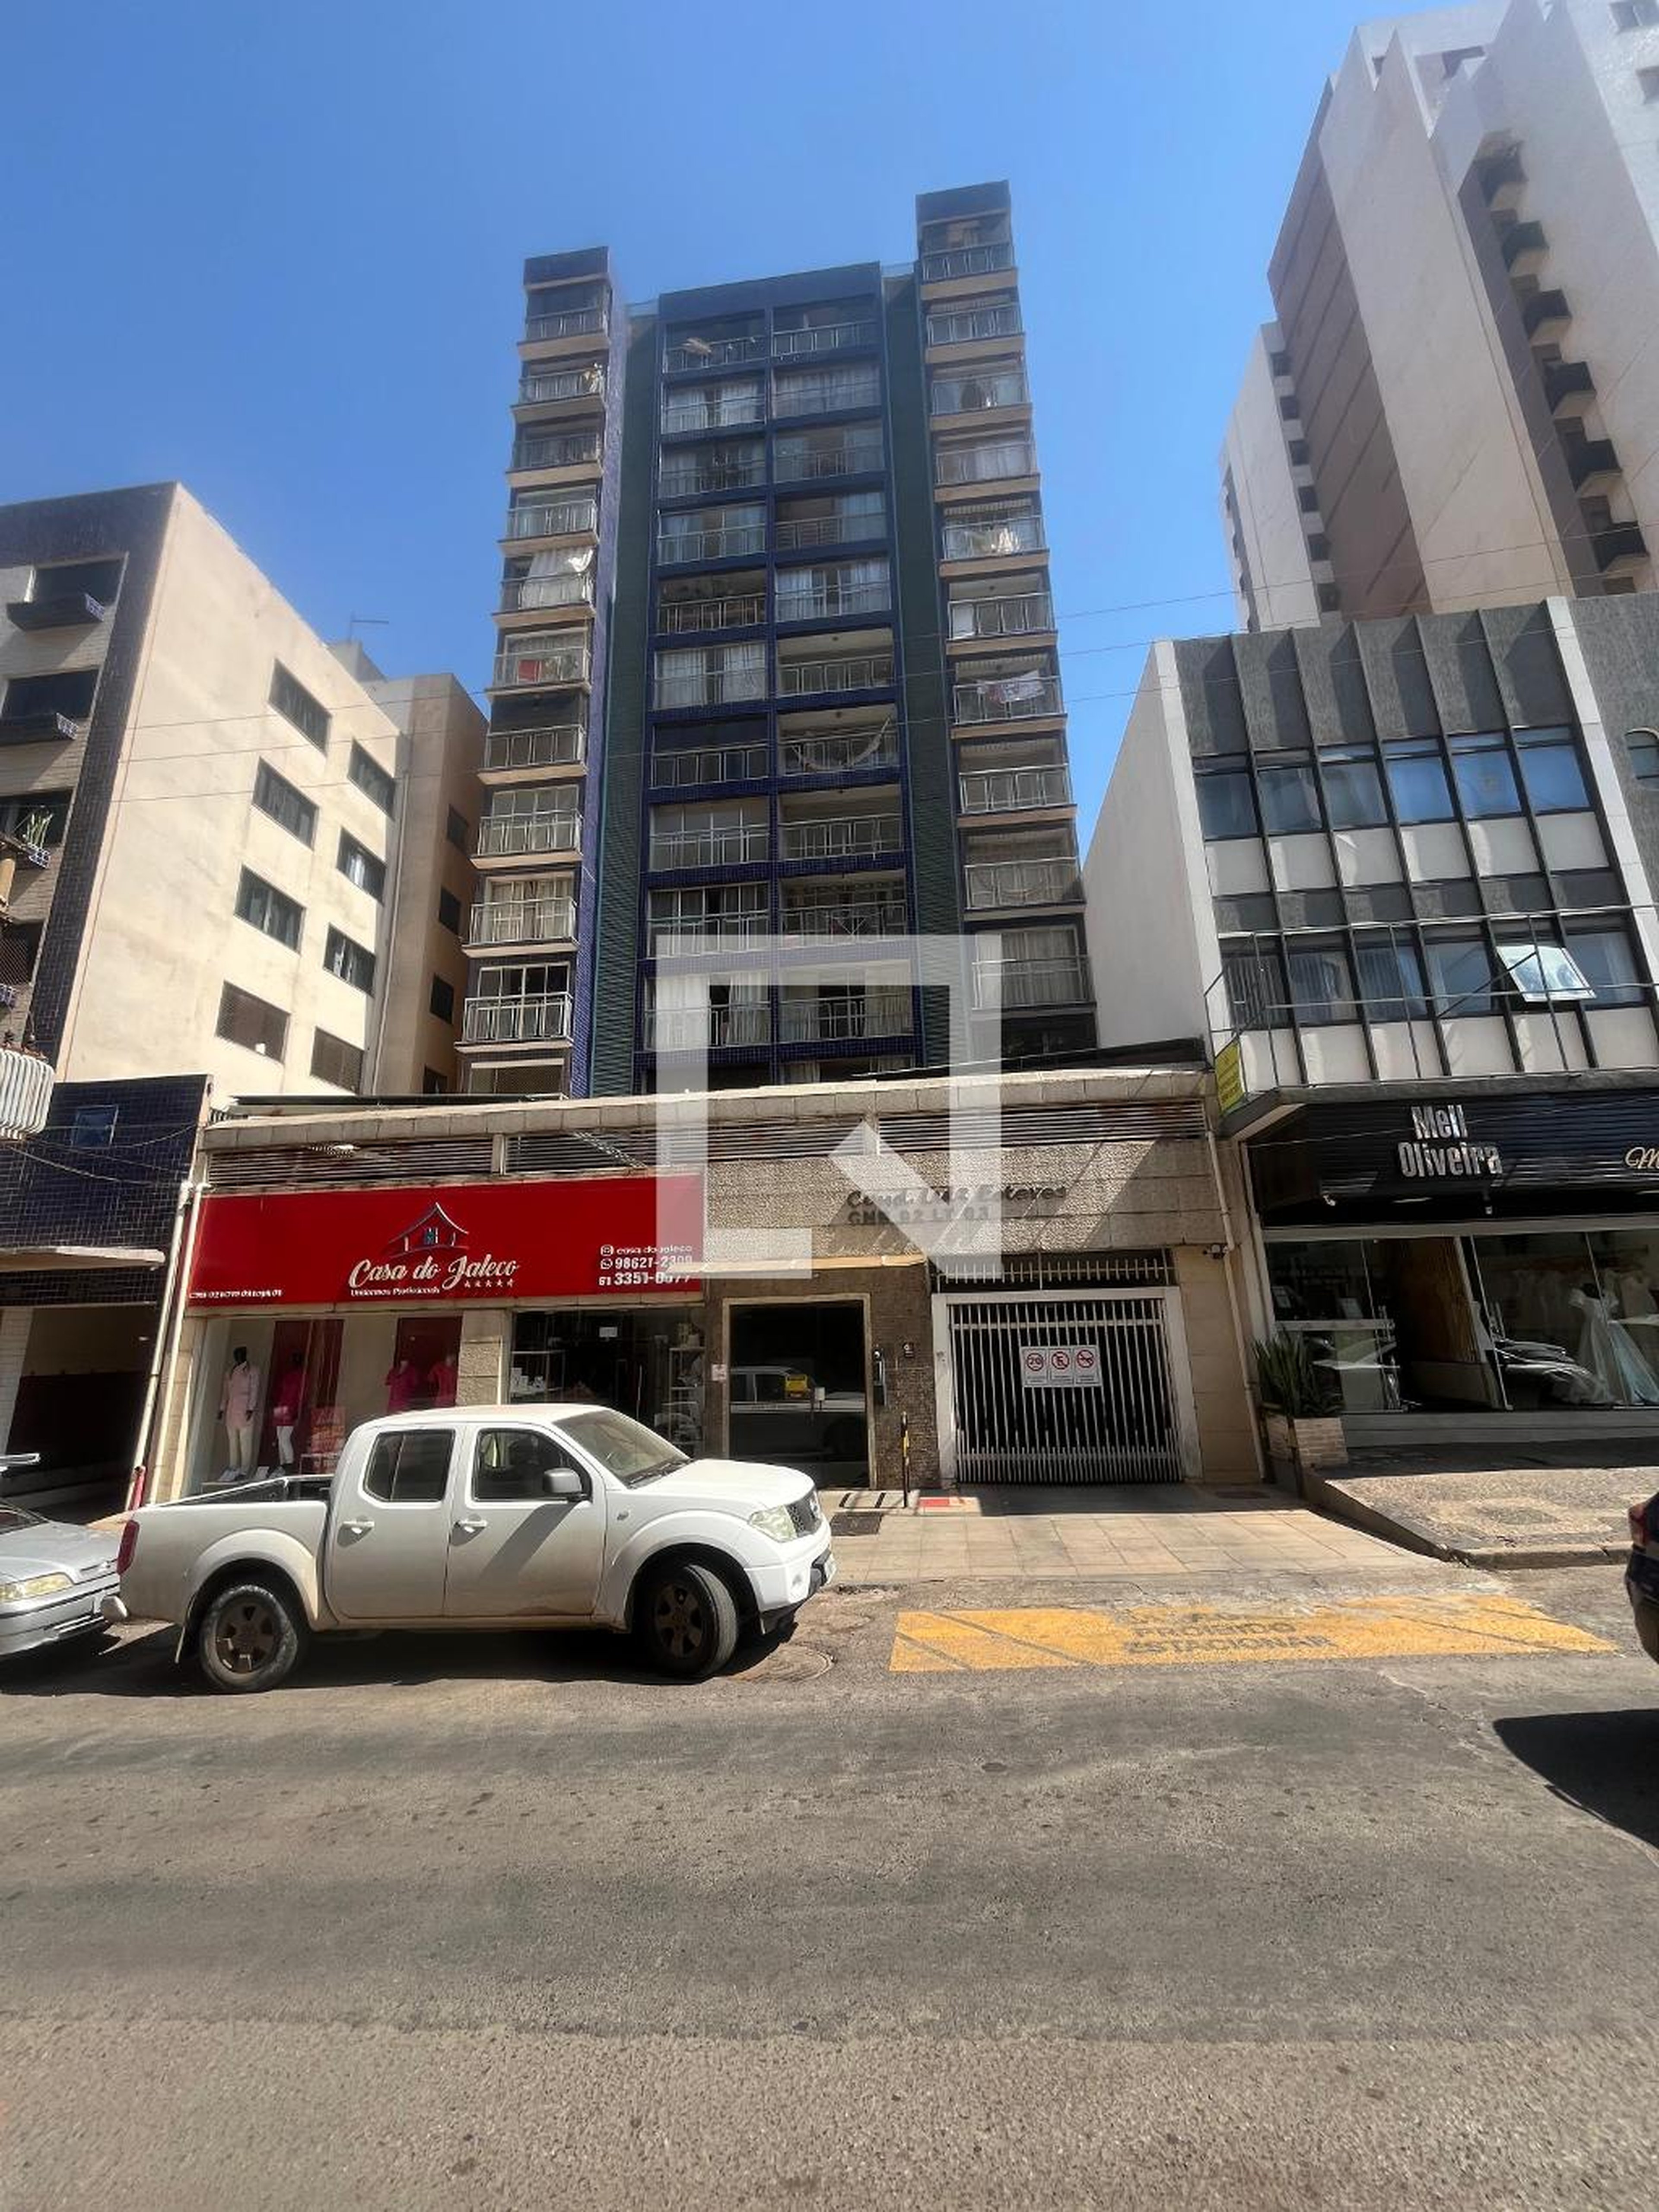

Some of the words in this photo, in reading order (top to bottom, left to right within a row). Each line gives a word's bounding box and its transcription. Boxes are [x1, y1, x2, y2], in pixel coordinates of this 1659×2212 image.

[1411, 1105, 1468, 1139] Mell
[1398, 1142, 1502, 1177] Oliveira
[348, 1259, 408, 1288] Casa
[413, 1255, 441, 1279] do
[442, 1254, 521, 1290] Jaleco
